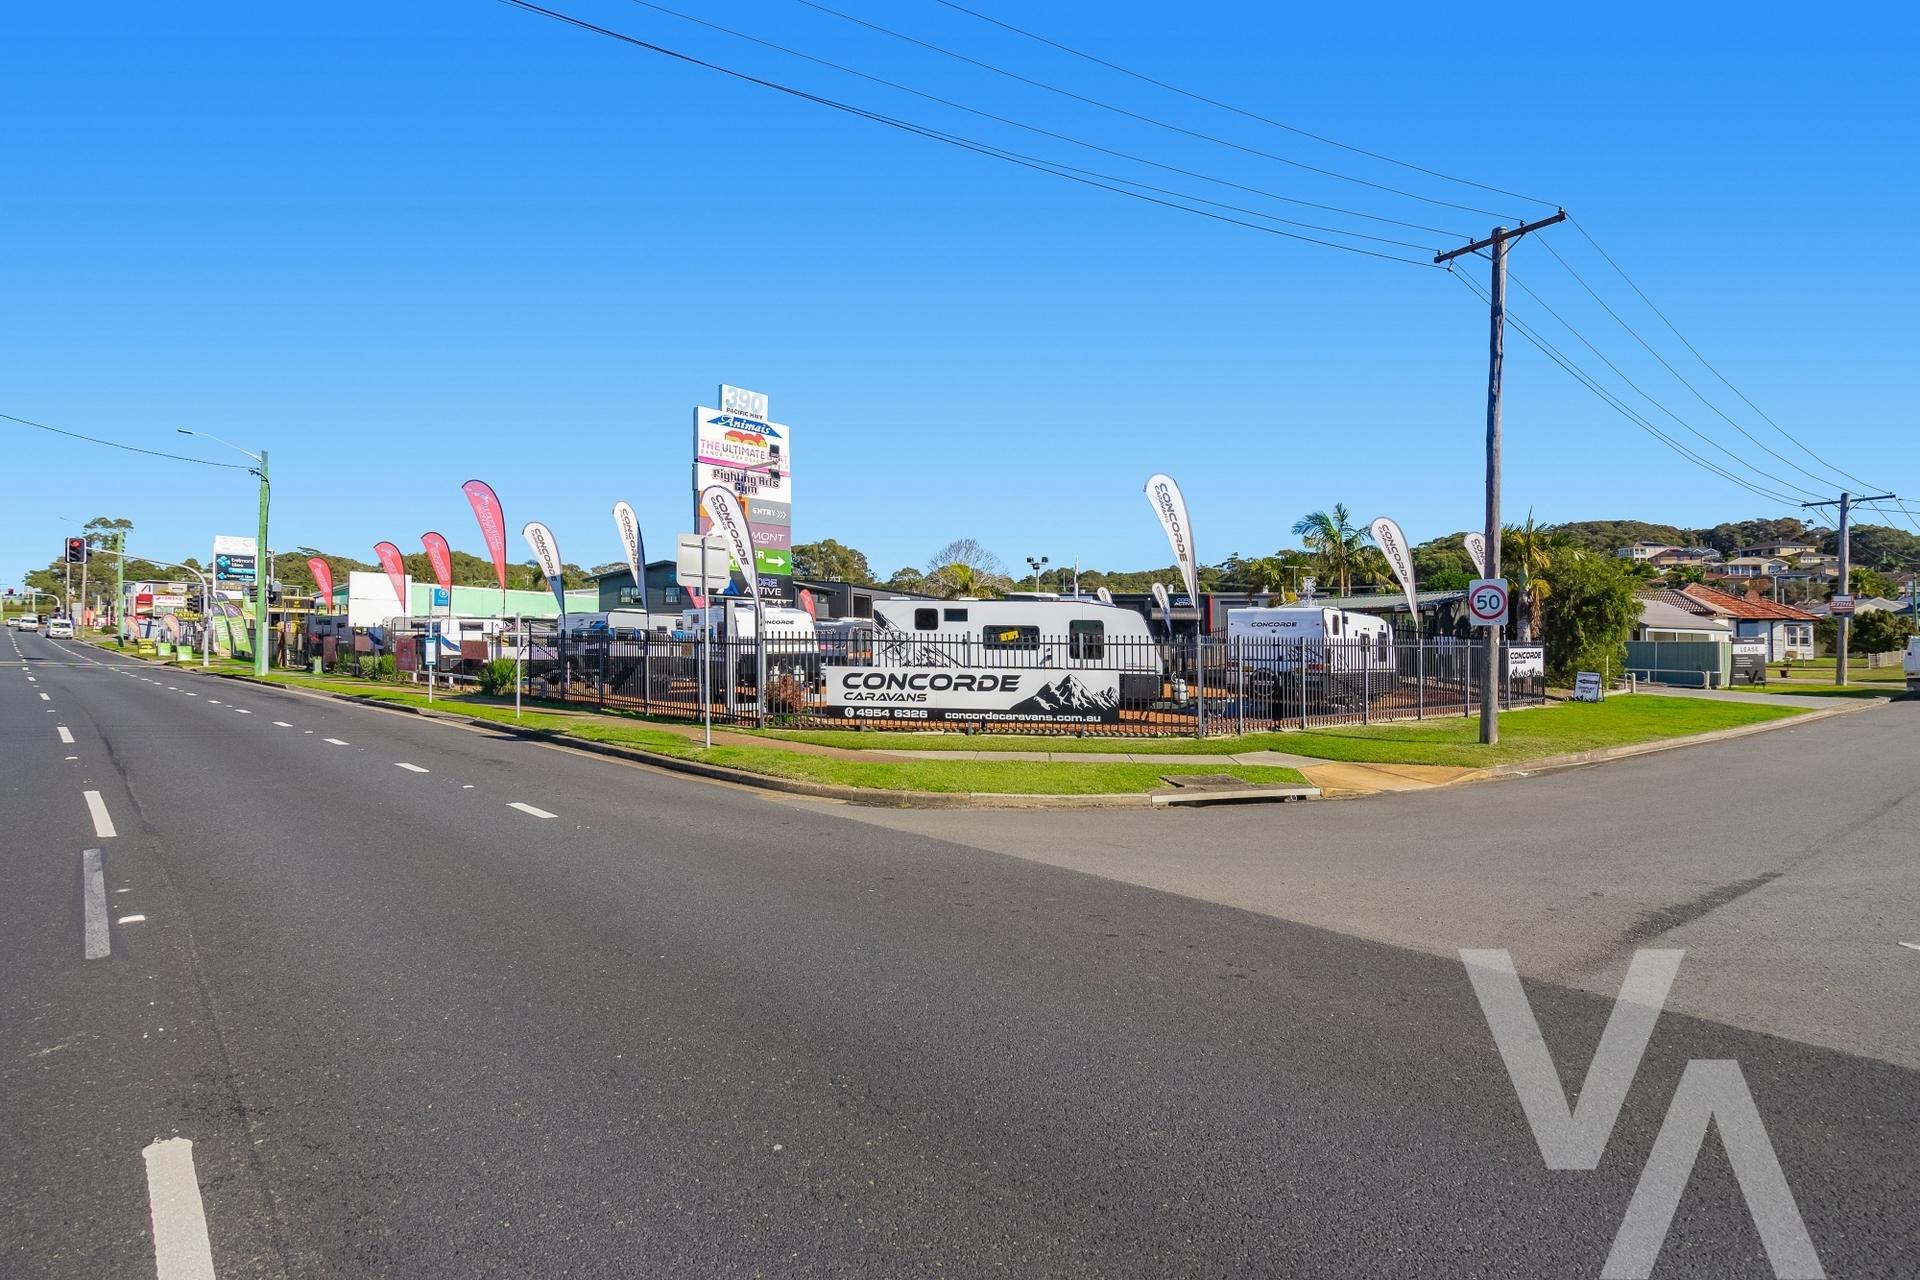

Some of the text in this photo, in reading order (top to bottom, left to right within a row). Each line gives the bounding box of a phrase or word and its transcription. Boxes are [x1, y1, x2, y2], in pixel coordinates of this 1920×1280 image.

[726, 388, 764, 413] 390
[726, 407, 763, 420] PACIFIC HWY
[700, 439, 721, 451] THE
[722, 443, 766, 460] ULTIMATE
[752, 507, 776, 517] ENTRY
[1160, 483, 1188, 562] CONCORDE
[716, 494, 749, 566] CONCORDE
[752, 532, 785, 542] MONT
[535, 528, 558, 581] CONCORDE
[1382, 524, 1409, 583] CONCORDE
[758, 577, 778, 588] ORE
[744, 586, 782, 596] ATIVE
[1477, 595, 1500, 610] 50
[1510, 651, 1542, 660] CONCORDE
[842, 672, 1023, 693] CONCORDE
[843, 692, 928, 703] CARAVANS
[856, 708, 1101, 722] 4954 6326 concordecaravans.com.au
